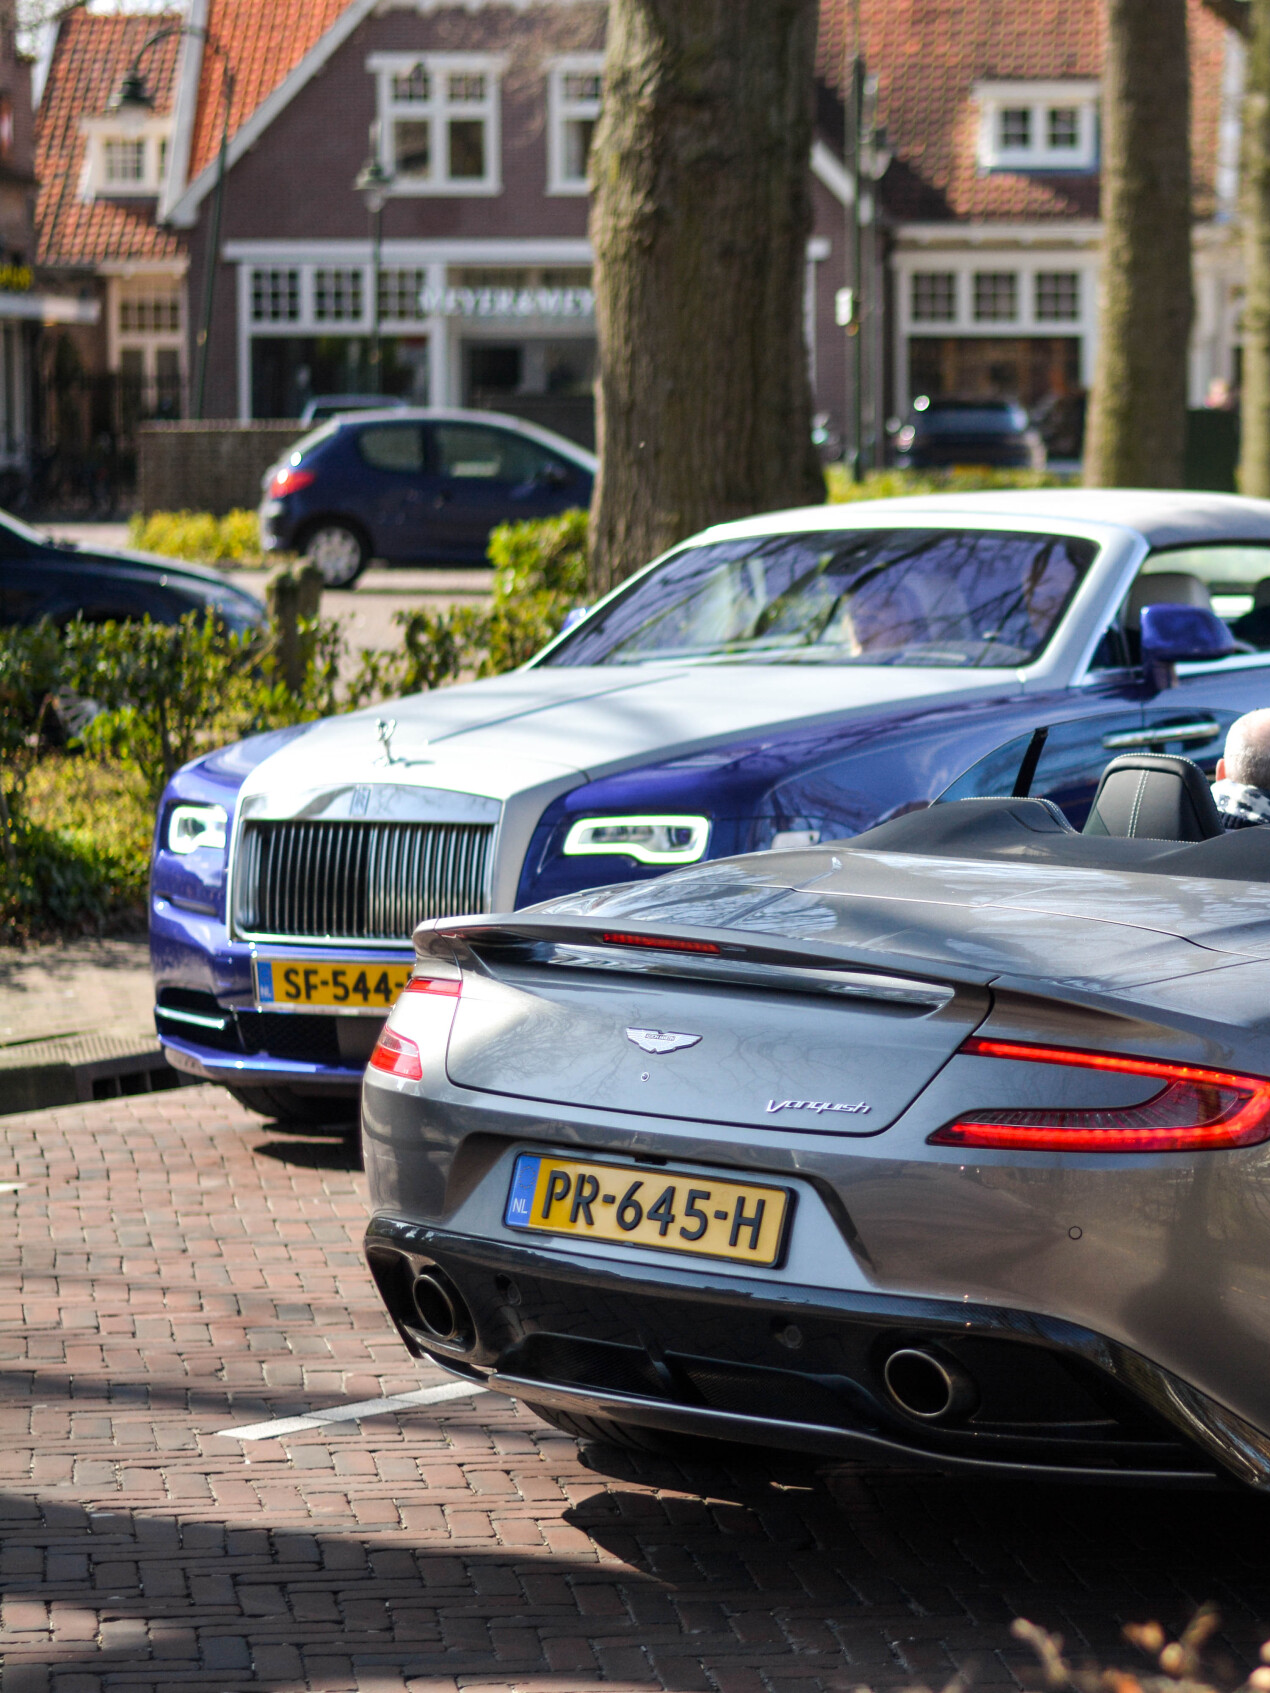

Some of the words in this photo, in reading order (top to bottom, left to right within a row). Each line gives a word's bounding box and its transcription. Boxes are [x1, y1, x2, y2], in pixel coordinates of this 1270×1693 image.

[284, 967, 412, 1003] SF-544-
[766, 1099, 872, 1114] Vanquish
[511, 1197, 528, 1215] NL
[541, 1169, 766, 1250] PR-645-H
